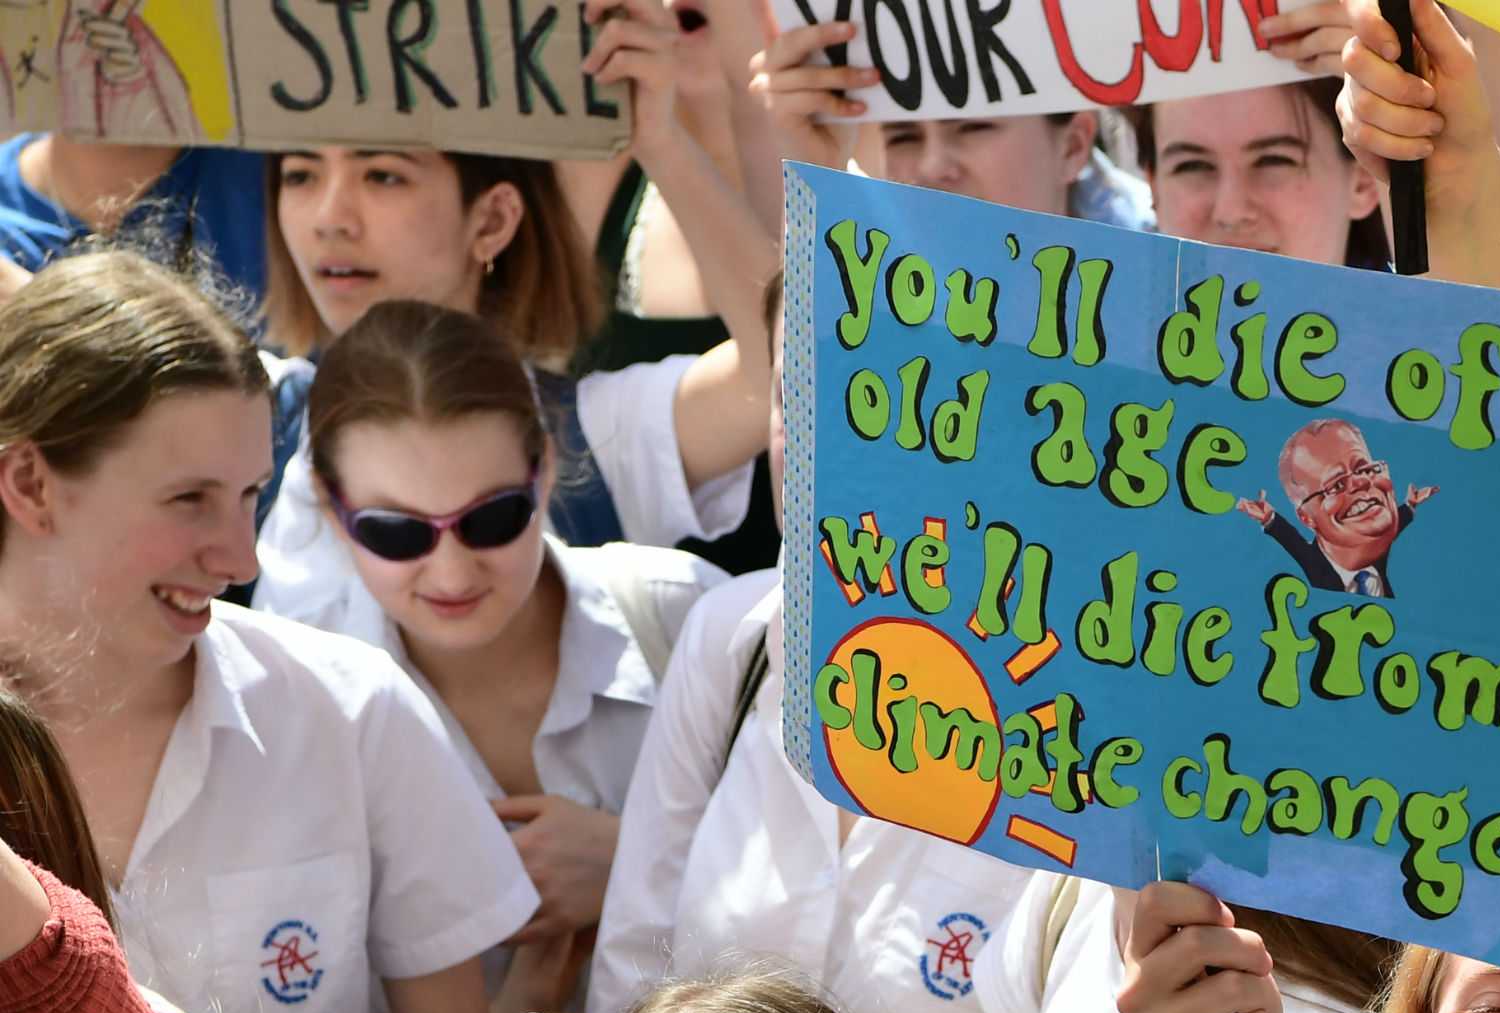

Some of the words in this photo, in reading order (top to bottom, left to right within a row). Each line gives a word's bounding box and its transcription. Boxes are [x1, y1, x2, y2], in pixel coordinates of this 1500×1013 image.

[1157, 274, 1346, 408] die
[846, 356, 990, 464] old
[1025, 382, 1248, 516] age
[1075, 550, 1234, 687] die
[814, 648, 1144, 813] climate
